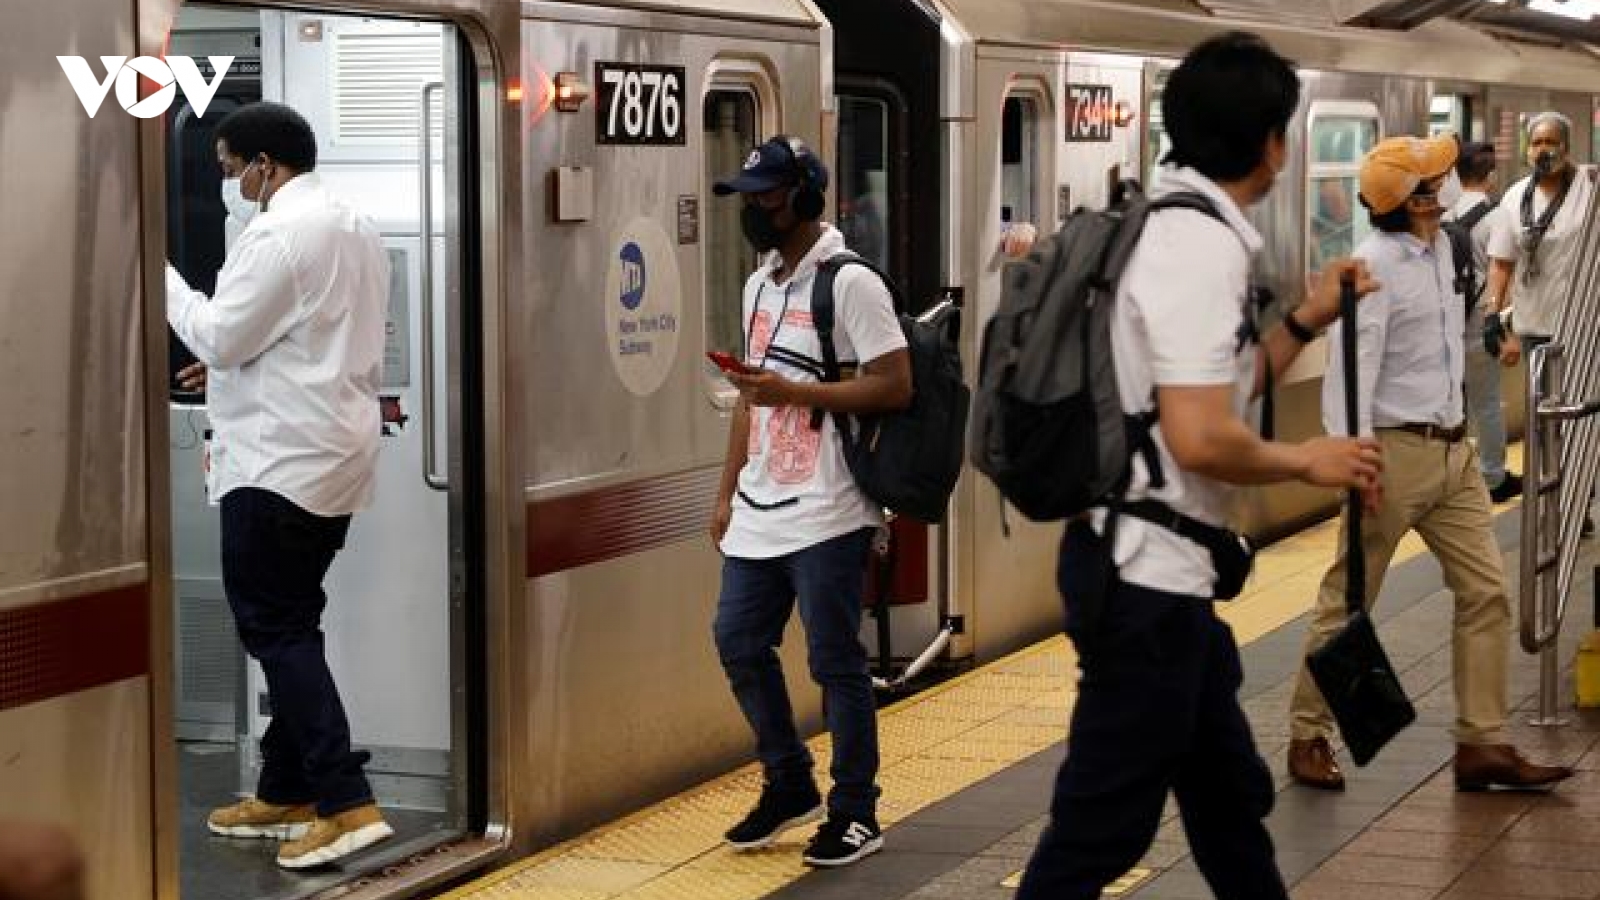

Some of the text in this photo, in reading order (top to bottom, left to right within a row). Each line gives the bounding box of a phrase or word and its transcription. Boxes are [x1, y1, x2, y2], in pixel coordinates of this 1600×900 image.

[602, 69, 680, 137] 7876
[1069, 88, 1109, 138] 7341
[659, 314, 676, 332] City
